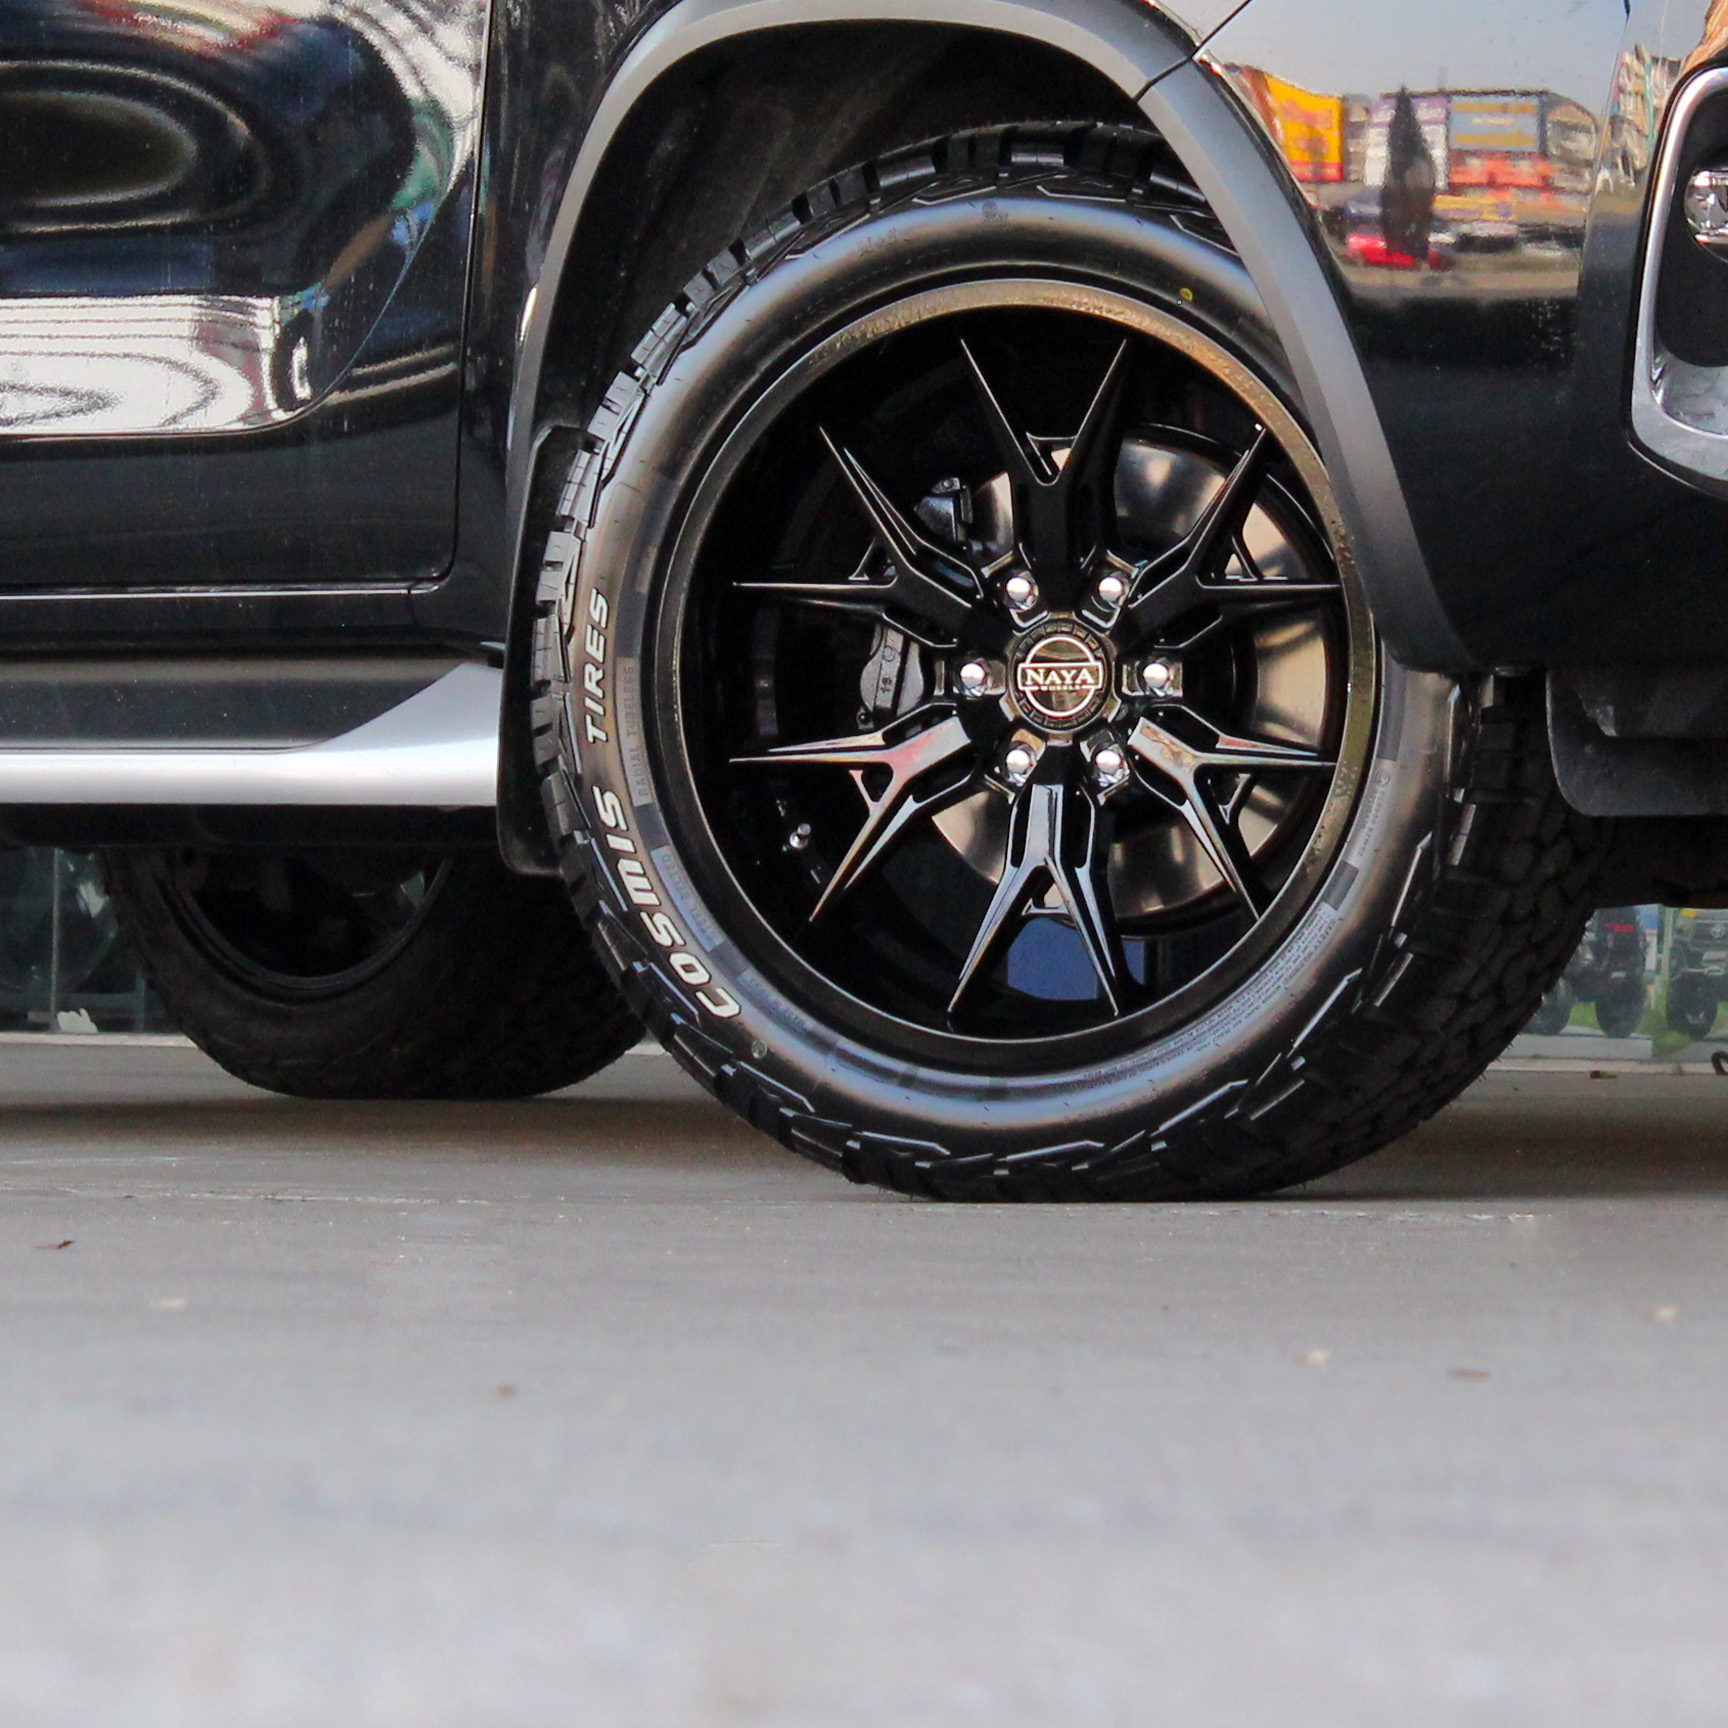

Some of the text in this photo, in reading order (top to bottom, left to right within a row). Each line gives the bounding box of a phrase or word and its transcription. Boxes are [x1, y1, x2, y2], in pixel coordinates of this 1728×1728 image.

[1024, 667, 1095, 685] NAYA
[582, 586, 742, 1020] COSMIS TIRES
